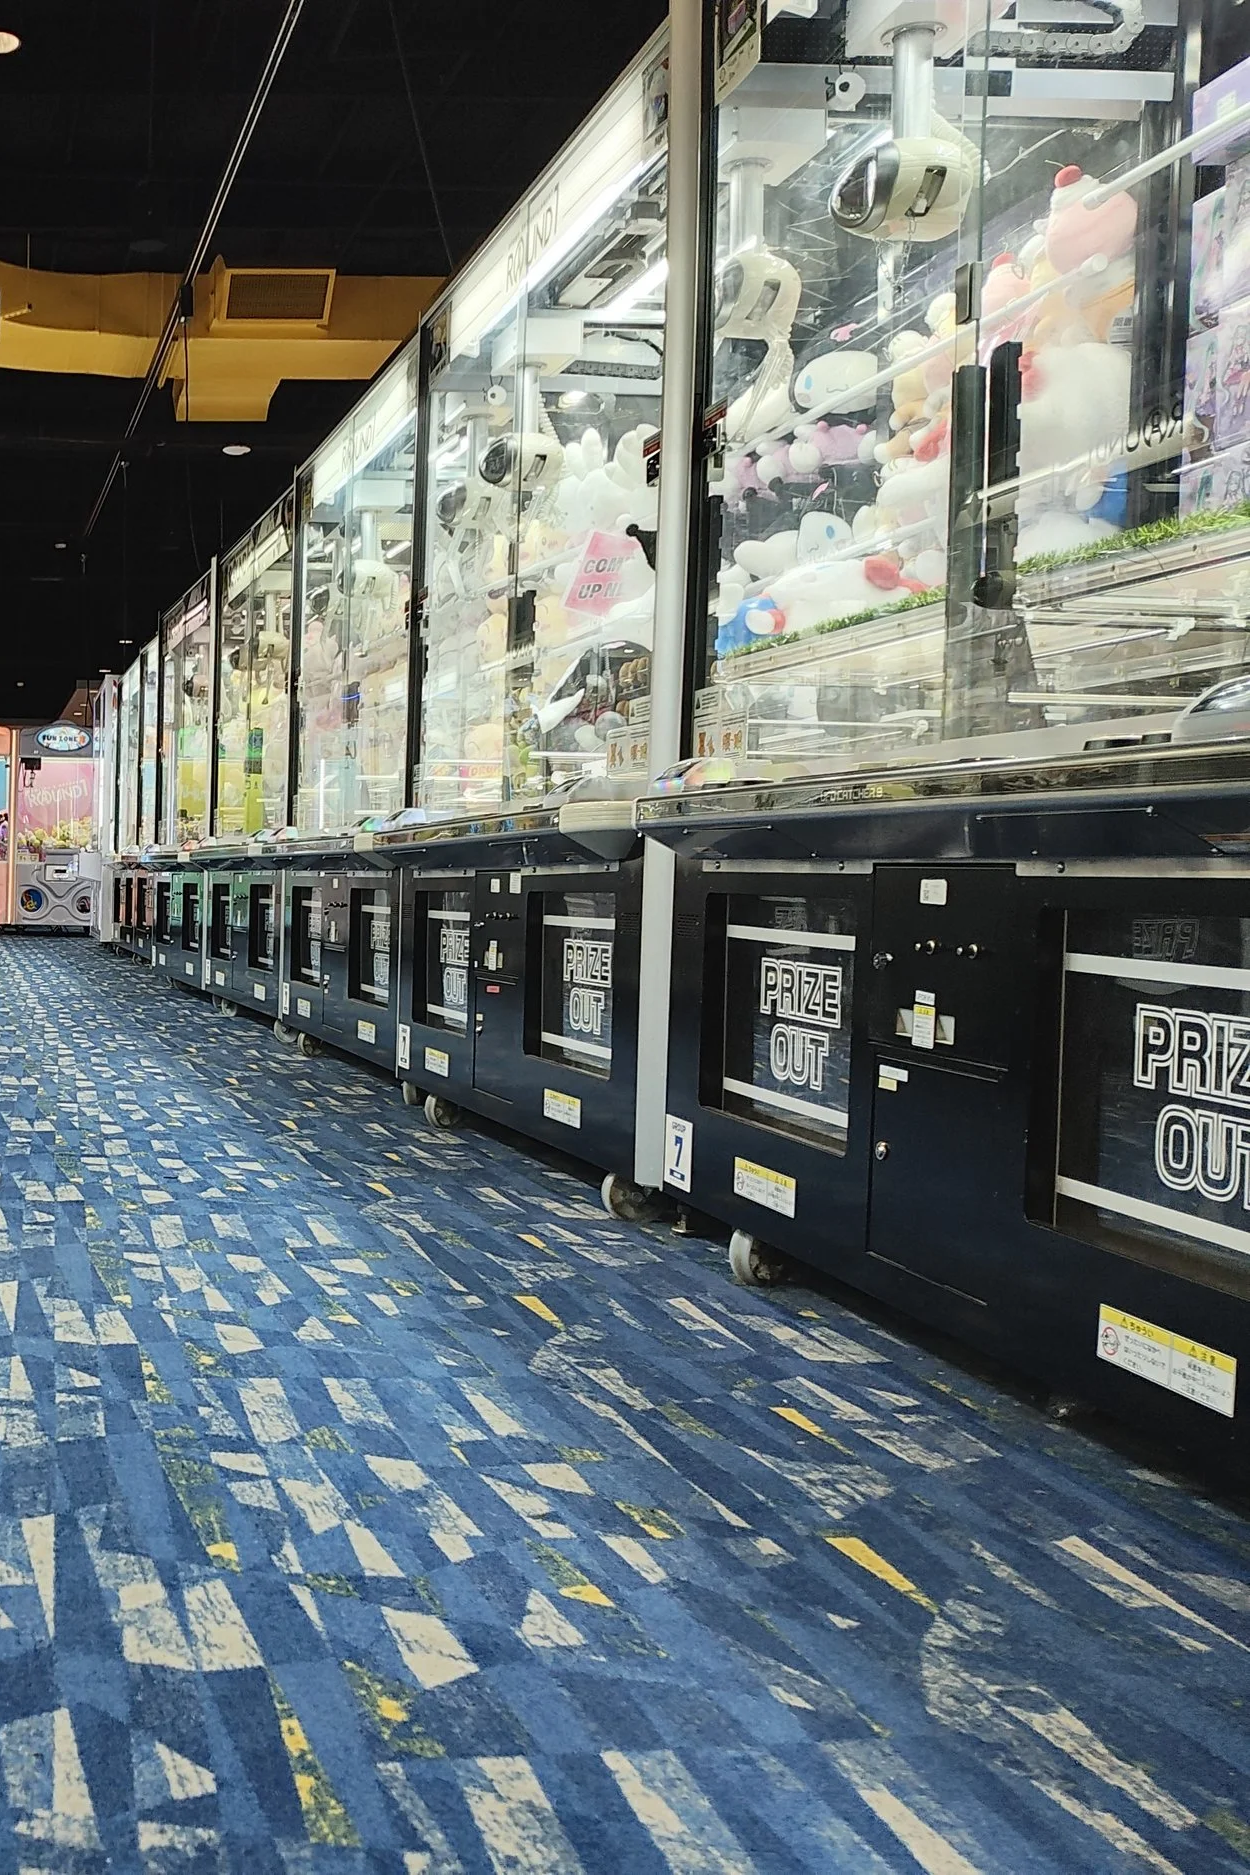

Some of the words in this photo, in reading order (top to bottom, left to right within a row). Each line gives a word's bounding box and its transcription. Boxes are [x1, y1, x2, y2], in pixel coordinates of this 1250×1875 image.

[577, 583, 602, 599] UP
[440, 929, 470, 967] PRIZE
[563, 938, 613, 988] PRIZE
[443, 967, 468, 1005] OUT
[760, 957, 842, 1029] PRIZE
[569, 987, 605, 1035] OUT
[770, 1023, 829, 1091] OUT
[675, 1135, 683, 1167] 7
